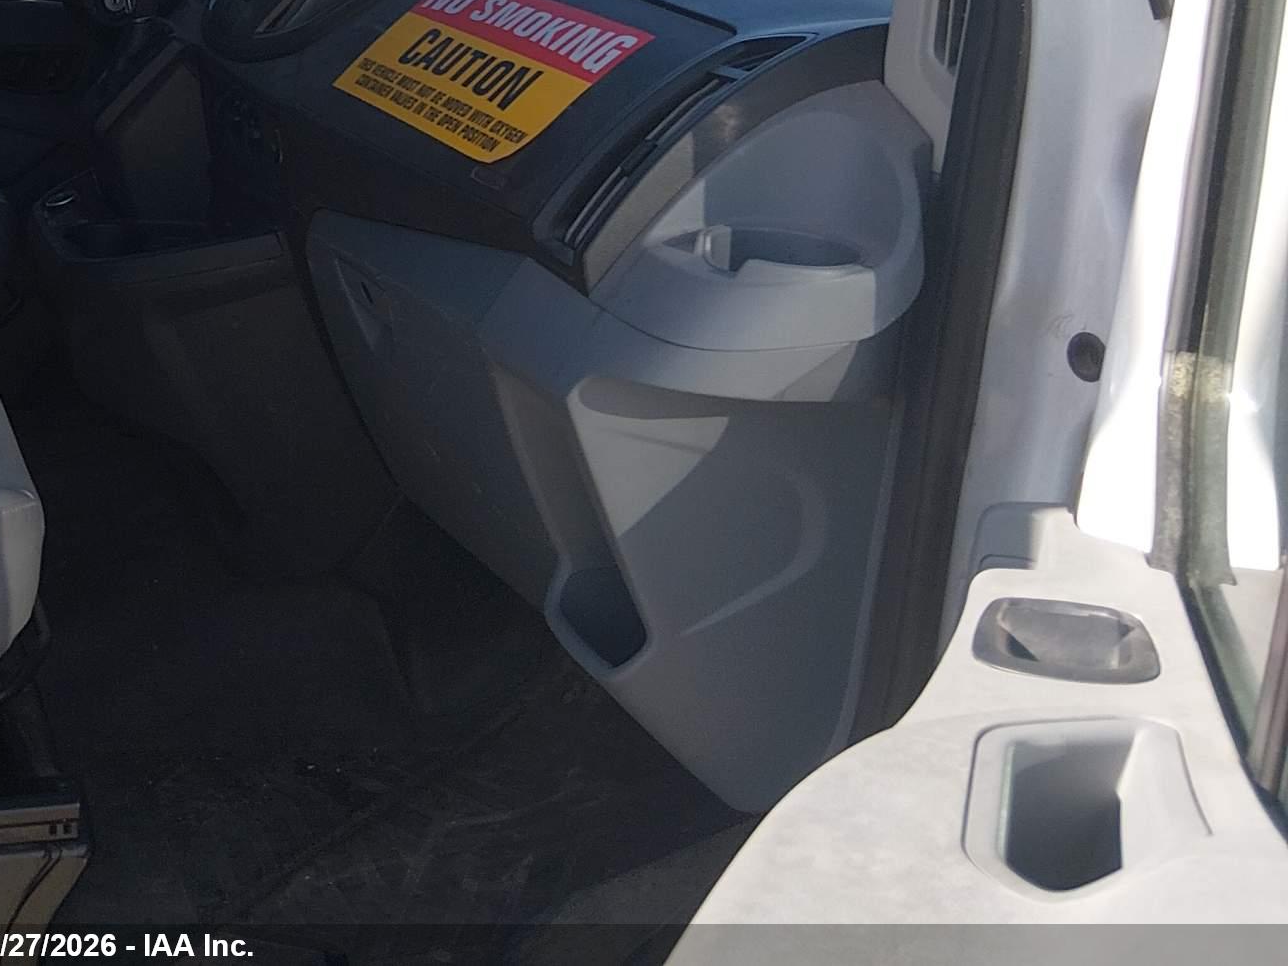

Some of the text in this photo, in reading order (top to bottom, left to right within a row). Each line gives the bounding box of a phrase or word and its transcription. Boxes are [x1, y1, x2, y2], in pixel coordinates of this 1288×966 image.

[372, 64, 402, 83] VEHICLE
[395, 75, 421, 91] MUST
[416, 84, 437, 99] NOT
[430, 91, 446, 105] BE
[441, 97, 473, 117] MOVED
[467, 109, 494, 128] WITH
[489, 120, 528, 144] OXYGEN
[398, 28, 544, 111] CAUTION
[355, 73, 500, 152] CONTAINER VALVES IN THE OPEN POSITION
